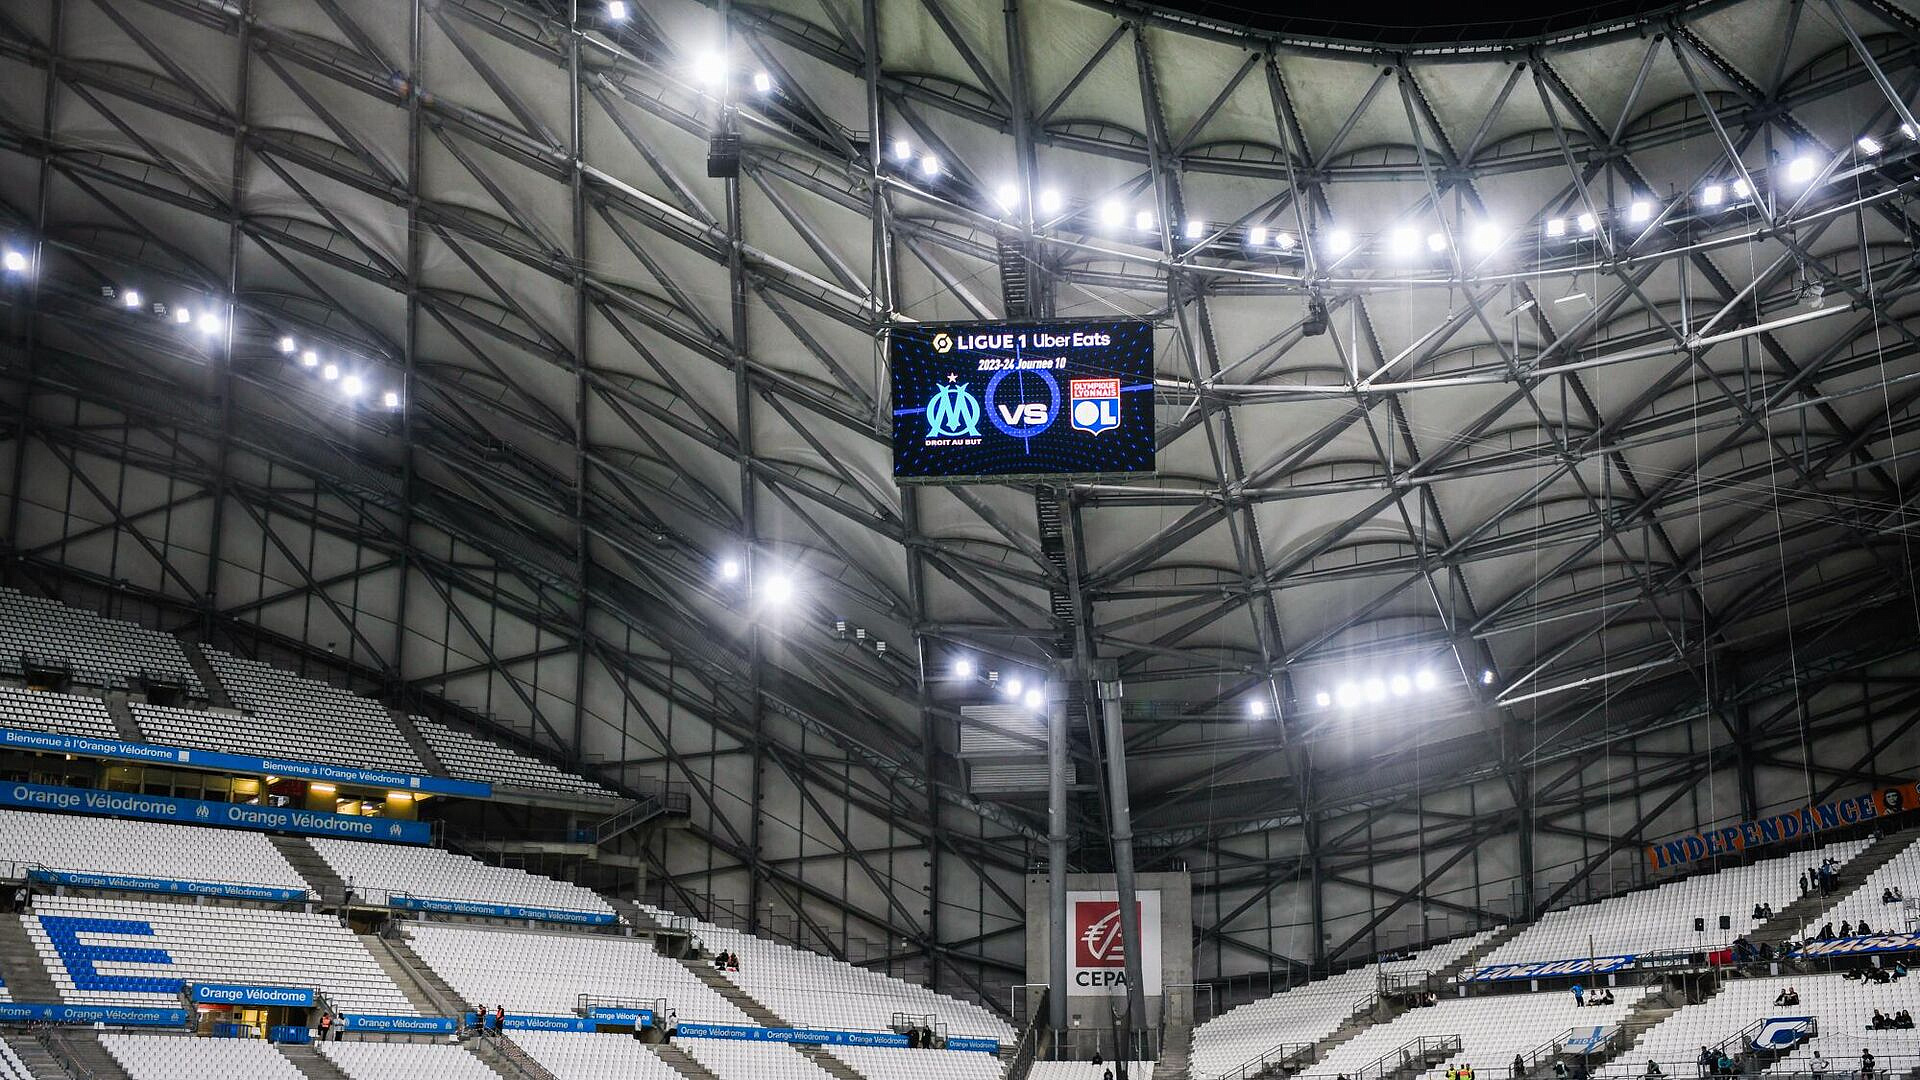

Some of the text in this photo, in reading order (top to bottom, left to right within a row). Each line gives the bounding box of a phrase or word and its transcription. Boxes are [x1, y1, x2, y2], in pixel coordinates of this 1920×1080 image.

[958, 332, 1111, 350] LIGUE 1 Uber Eats
[977, 358, 1015, 371] 2023-24
[1054, 357, 1067, 369] 10
[1074, 382, 1117, 390] OLYMPIQUE
[1074, 389, 1117, 397] LYONNAIS
[1074, 401, 1117, 426] OL
[6, 732, 173, 759] Bienvenue à l'Orange Vélodrome
[262, 760, 406, 785] Bienvenue à l'Orange Vélodrome
[13, 785, 177, 815] Orange Vélodrome
[228, 806, 373, 833] Orange Vélodrome
[1654, 792, 1878, 869] INDEPENDANCE
[69, 874, 160, 890] Orange Vélodrome
[188, 882, 273, 898] Orange Vélodrome
[422, 900, 452, 912] Orange
[518, 905, 547, 918] Orange
[1076, 971, 1128, 987] CEPA
[200, 987, 306, 1002] Orange Vélodrome
[64, 1008, 160, 1021] Orange Vélodrome
[358, 1018, 438, 1030] Orange Vélodrome
[503, 1018, 569, 1029] range Vélodrome
[680, 1026, 746, 1038] Orange Vélodrome
[767, 1030, 793, 1040] Orange
[849, 1034, 873, 1044] Orange
